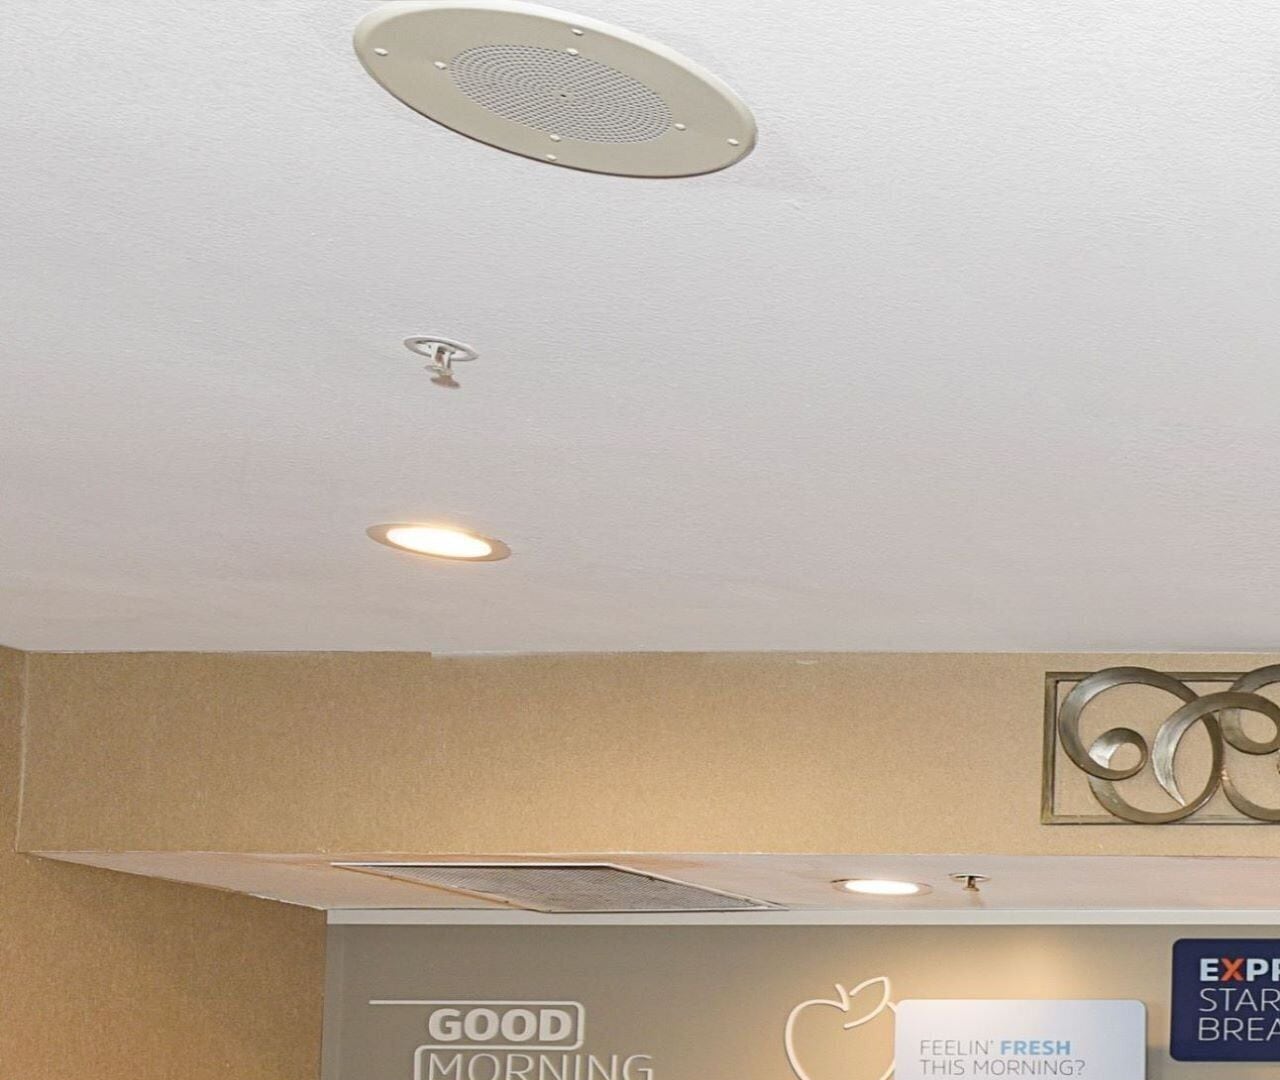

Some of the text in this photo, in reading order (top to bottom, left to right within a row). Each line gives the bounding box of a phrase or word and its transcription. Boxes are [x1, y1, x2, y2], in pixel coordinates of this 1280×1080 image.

[429, 1008, 572, 1042] GOOD
[920, 1039, 1071, 1056] FEELIN' FRESH
[920, 1059, 1086, 1076] THIS MORNING?
